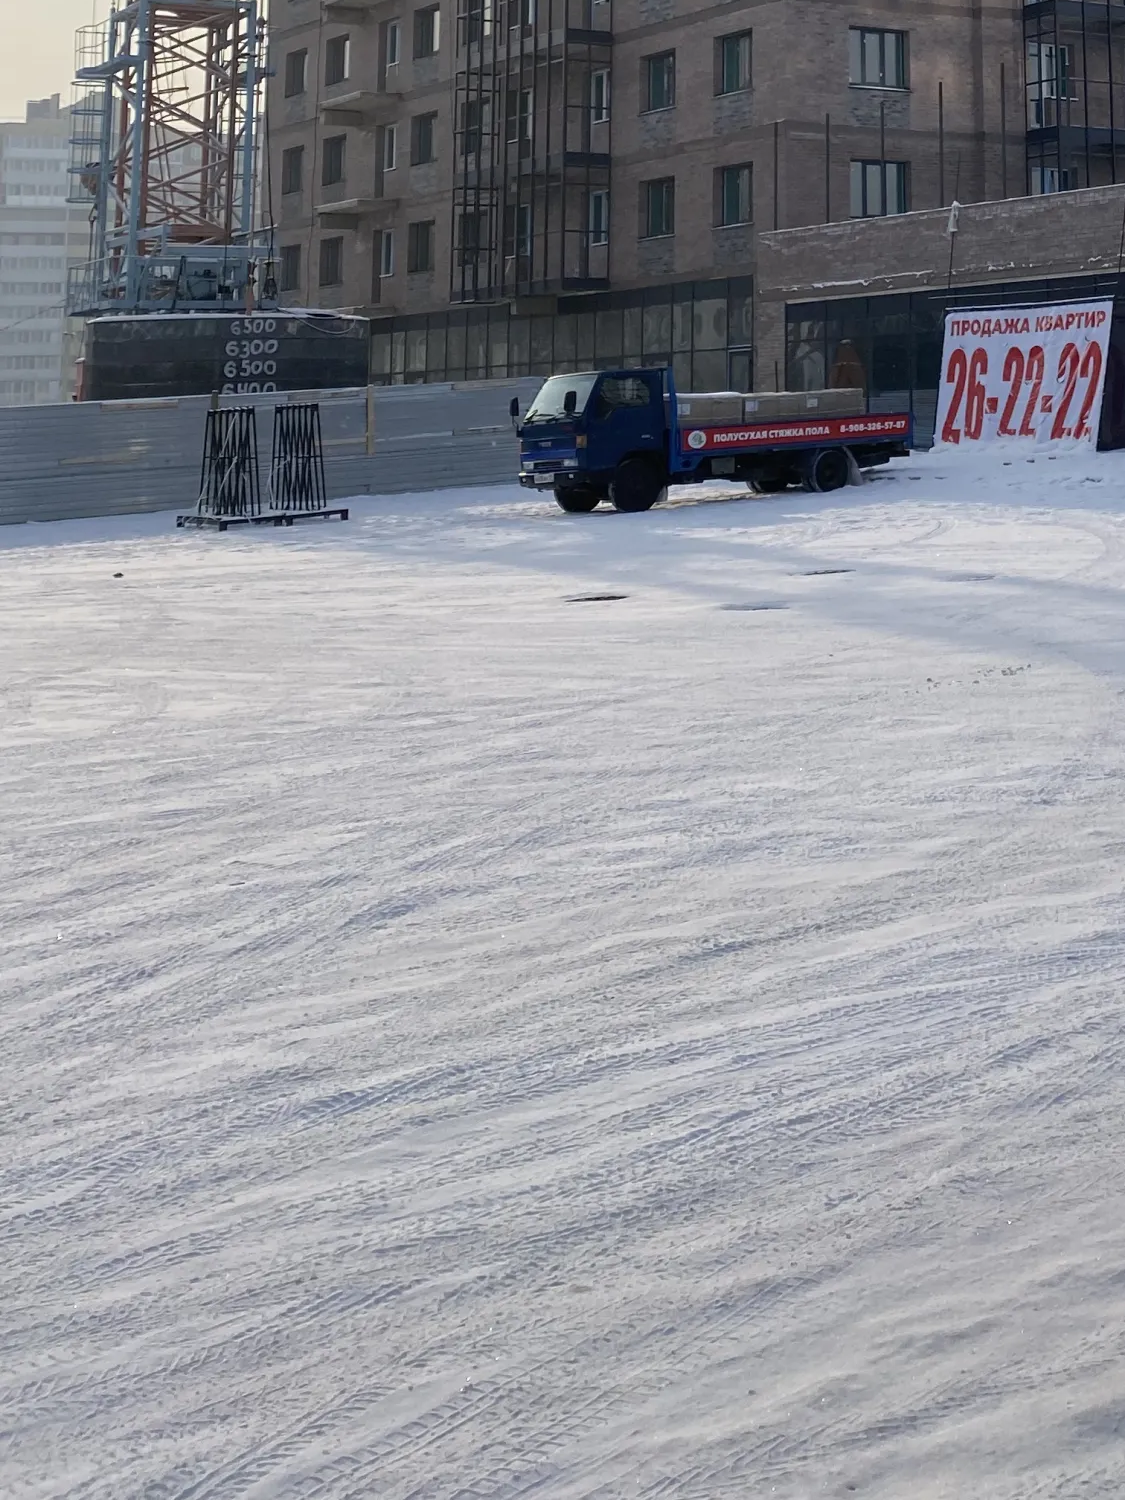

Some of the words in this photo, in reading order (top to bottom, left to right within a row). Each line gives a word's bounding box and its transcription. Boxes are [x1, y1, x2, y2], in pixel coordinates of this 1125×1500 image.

[230, 319, 276, 335] 6500
[950, 317, 1030, 338] ПРОДАЖА
[1035, 310, 1106, 332] КВАРТИР
[225, 340, 278, 358] 6300
[223, 360, 277, 378] 6500
[941, 341, 1102, 444] 26-22-22
[713, 430, 767, 443] ПОЛУСУХАЯ
[768, 427, 804, 439] СТЯЖКА
[805, 426, 830, 436] ПОЛА
